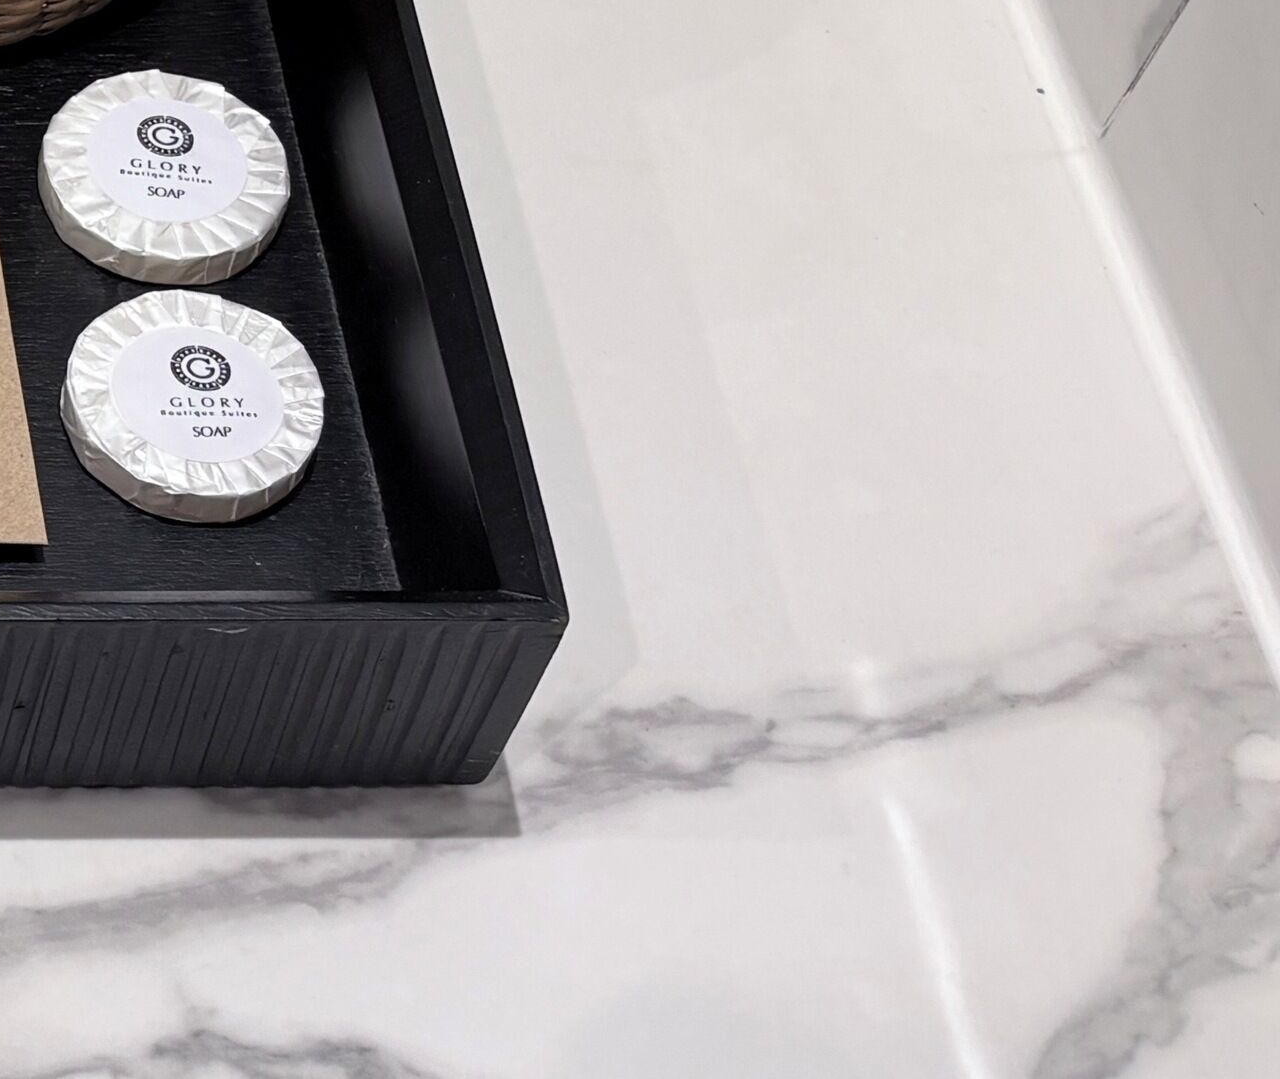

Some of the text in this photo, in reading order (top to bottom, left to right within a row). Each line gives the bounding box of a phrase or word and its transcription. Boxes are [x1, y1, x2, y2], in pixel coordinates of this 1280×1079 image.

[130, 158, 202, 174] GLORY
[120, 169, 213, 184] Boutique Suites
[147, 186, 185, 199] SOAP
[170, 397, 244, 408] GLORY
[160, 409, 258, 418] Boutique Suites
[192, 426, 232, 437] SOAP
